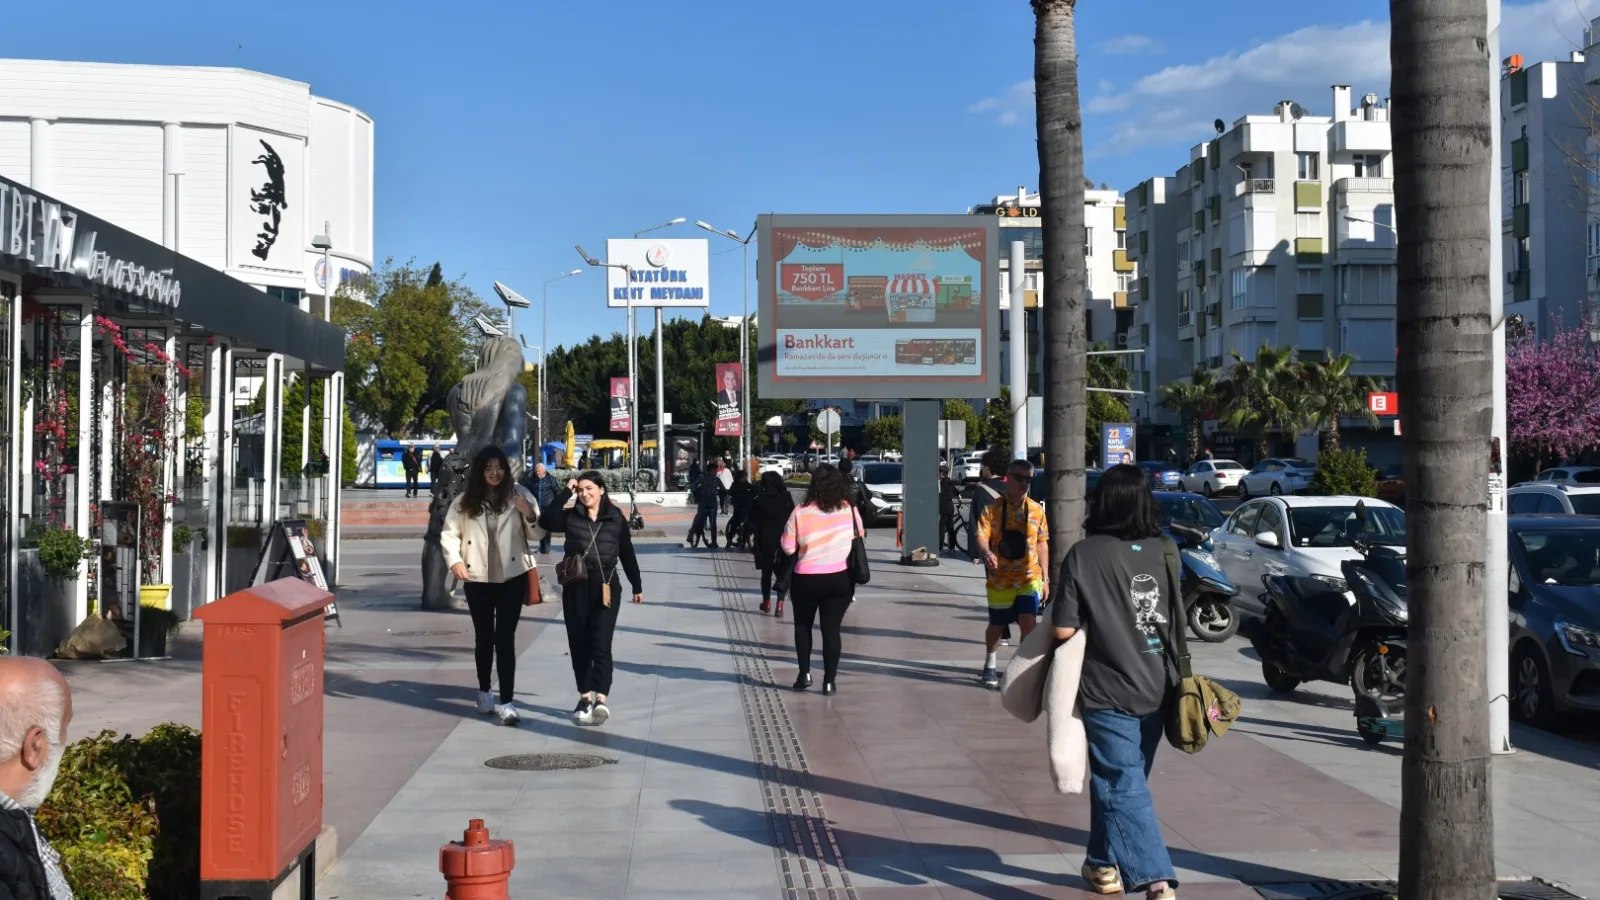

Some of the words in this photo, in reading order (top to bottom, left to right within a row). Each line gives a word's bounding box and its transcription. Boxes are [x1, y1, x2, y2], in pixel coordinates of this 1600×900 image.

[630, 266, 687, 283] ATATÜRK
[792, 273, 817, 284] 750
[820, 273, 834, 284] TL
[650, 287, 703, 300] MEYDANI
[784, 334, 854, 349] Bankkart
[784, 352, 825, 360] Ramazan'da
[827, 352, 835, 360] da
[1108, 428, 1120, 438] 22
[227, 691, 246, 857] FIREHOSE
